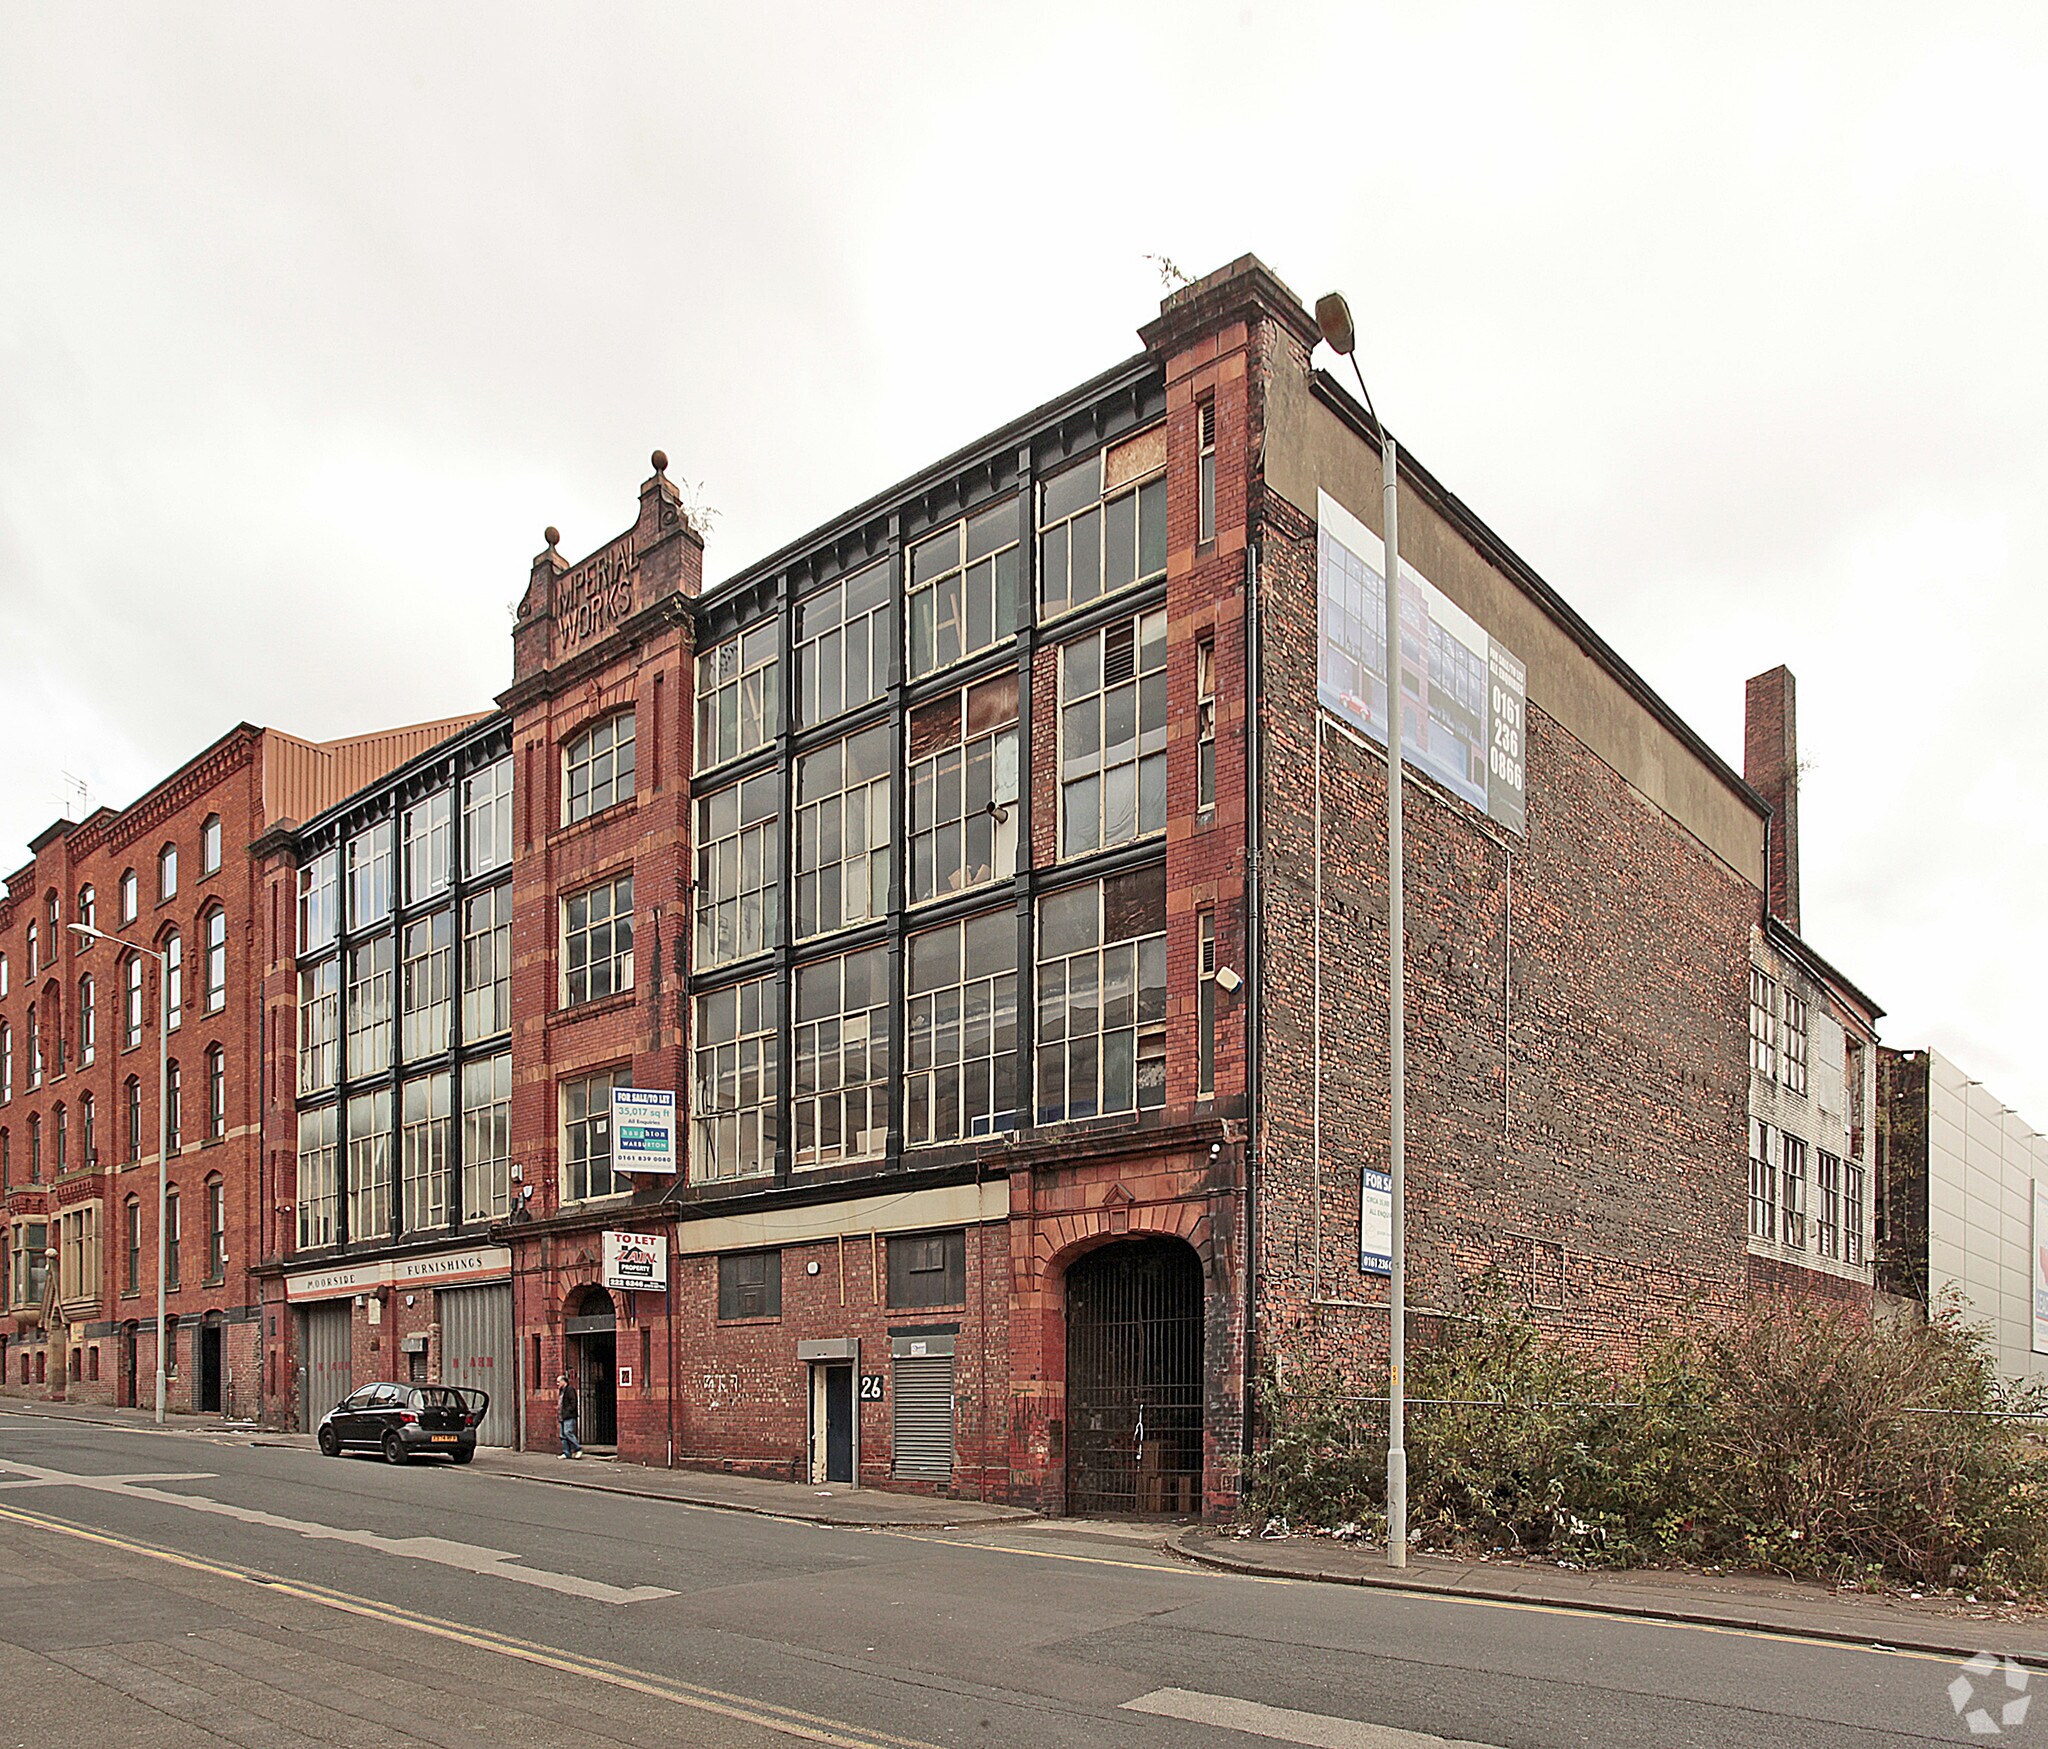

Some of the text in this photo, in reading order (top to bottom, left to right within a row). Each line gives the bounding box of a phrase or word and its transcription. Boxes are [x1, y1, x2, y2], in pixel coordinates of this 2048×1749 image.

[559, 579, 632, 650] WORKS
[1492, 684, 1520, 730] 0161
[1494, 717, 1518, 758] 236
[1490, 745, 1522, 792] 0866
[618, 1092, 631, 1102] FOR
[658, 1095, 670, 1104] LET
[618, 1107, 670, 1118] 35,017 sq ft
[1365, 1172, 1383, 1190] FOR
[614, 1234, 656, 1245] TO LET
[617, 1250, 656, 1264] ZAIN
[1363, 1255, 1378, 1268] 0161
[1377, 1258, 1389, 1270] 236
[307, 1257, 483, 1289] MOORSIDE FURNISHINGS
[861, 1377, 881, 1398] 26
